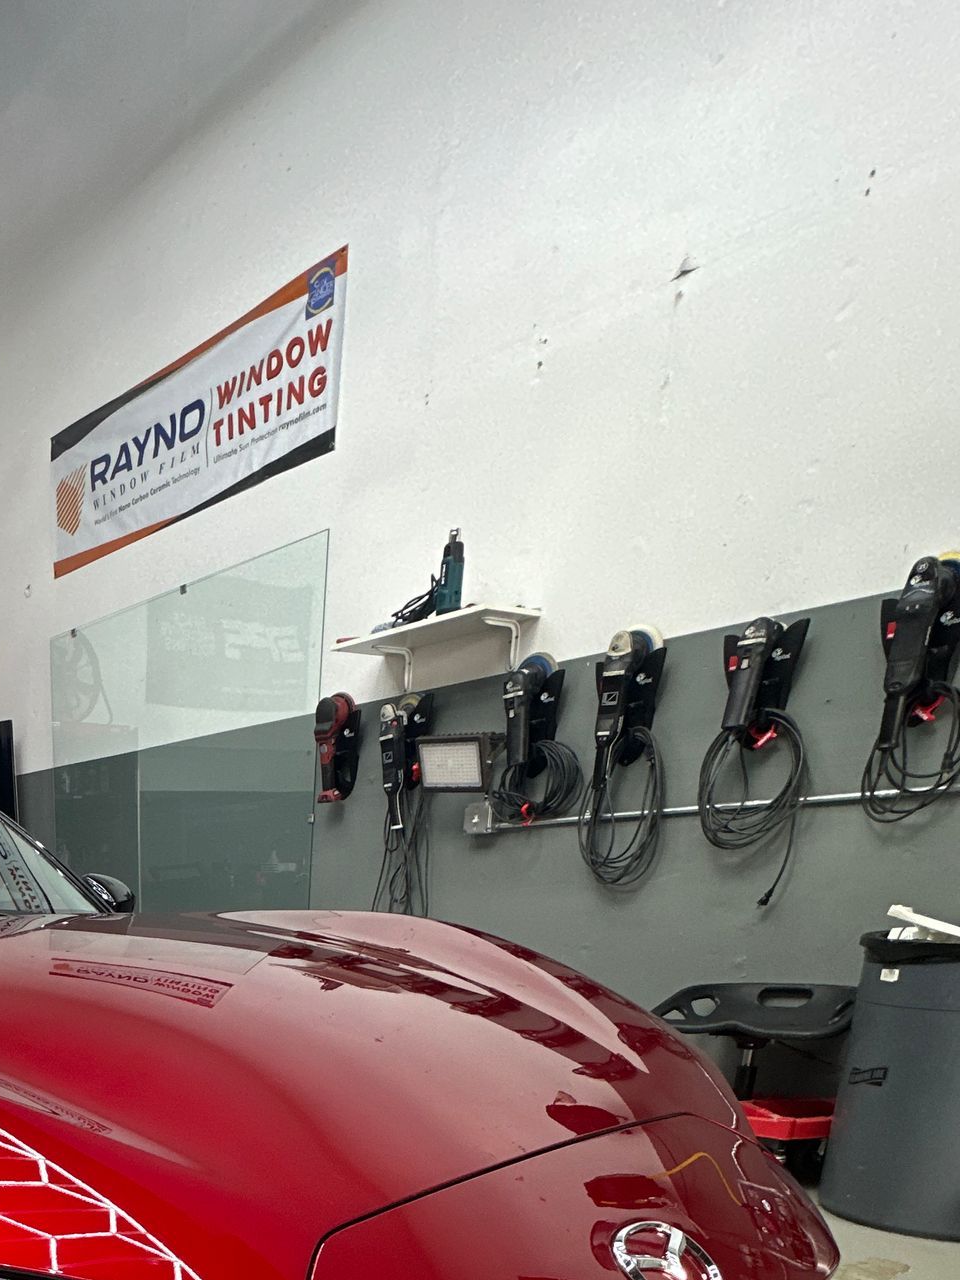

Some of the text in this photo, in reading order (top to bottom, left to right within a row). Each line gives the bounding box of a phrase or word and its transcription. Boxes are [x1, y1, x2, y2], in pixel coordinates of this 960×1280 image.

[216, 318, 333, 410] WINDOW
[90, 399, 206, 492] RAYNO
[213, 366, 328, 447] TINTING
[93, 441, 200, 511] WINDOW FILM
[118, 503, 131, 513] Nano
[132, 492, 149, 506] Carbon
[149, 480, 171, 496] Ceramic
